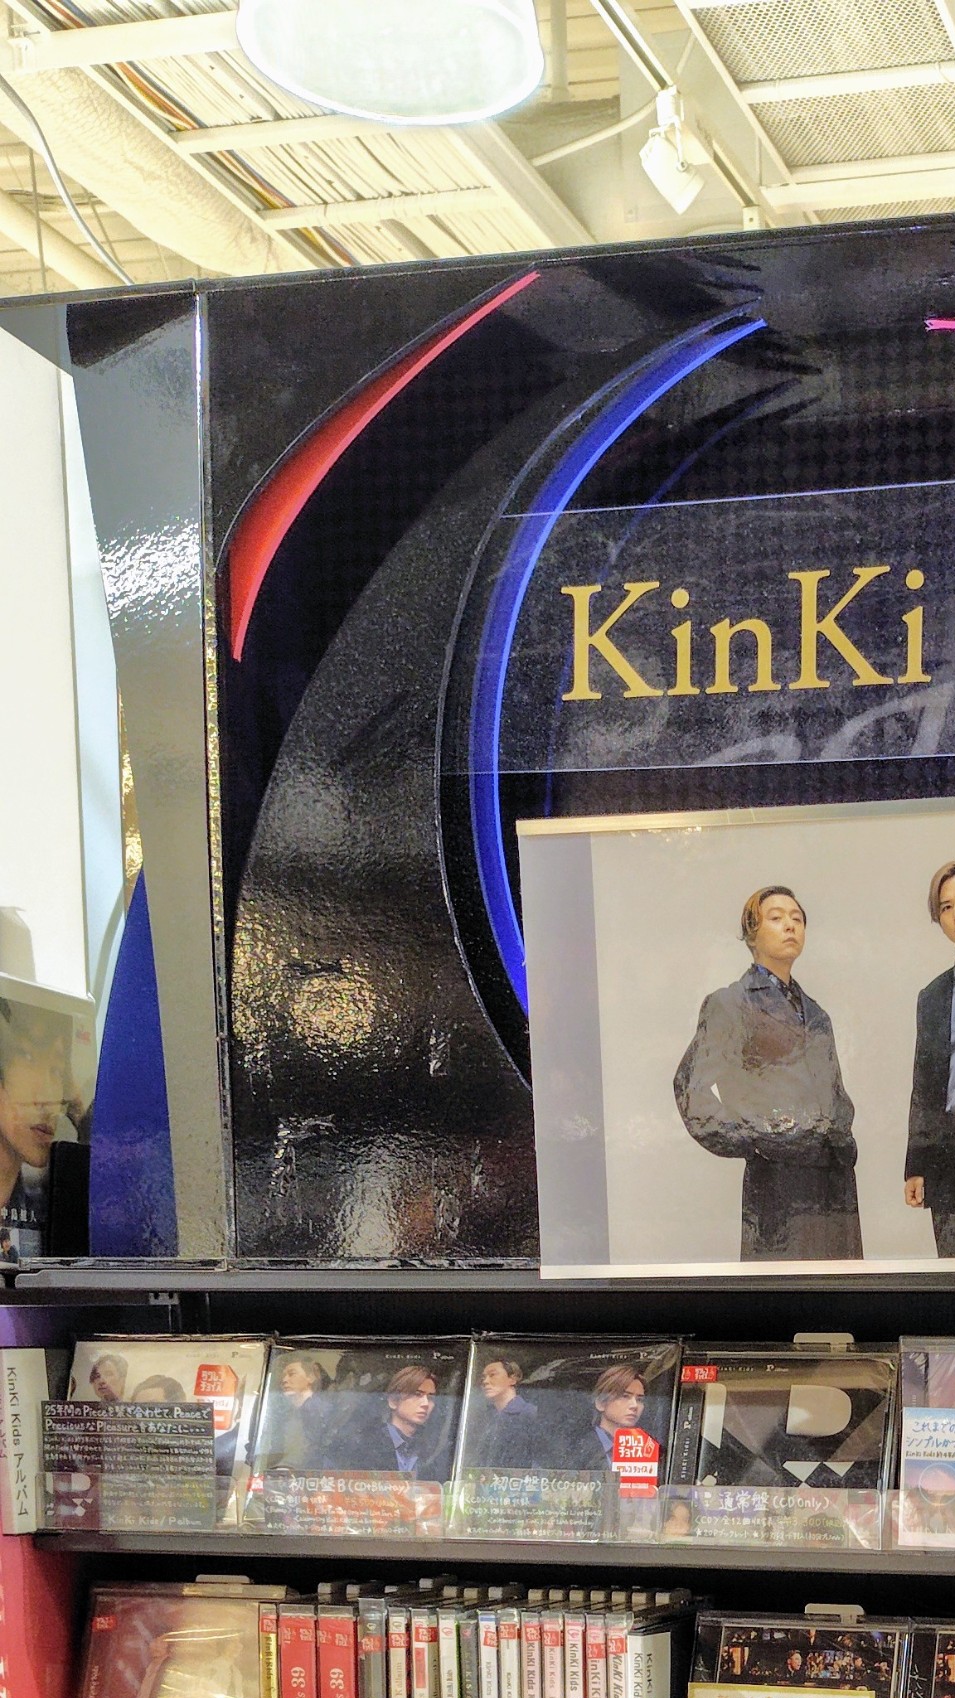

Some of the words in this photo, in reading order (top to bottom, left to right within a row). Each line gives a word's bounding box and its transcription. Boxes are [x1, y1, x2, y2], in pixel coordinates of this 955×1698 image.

[561, 566, 931, 702] KinKi
[7, 1367, 20, 1407] KinKi
[11, 1413, 21, 1445] Kids
[619, 1435, 643, 1446] タワレコ
[618, 1447, 643, 1458] チョイス
[14, 1453, 28, 1516] アルバム
[527, 1642, 535, 1667] KinKi
[614, 1654, 623, 1678] KinKi
[634, 1652, 643, 1678] KinKi
[291, 1667, 306, 1688] 39
[329, 1668, 344, 1690] 39
[527, 1670, 535, 1691] Kids
[590, 1659, 600, 1684] inKi
